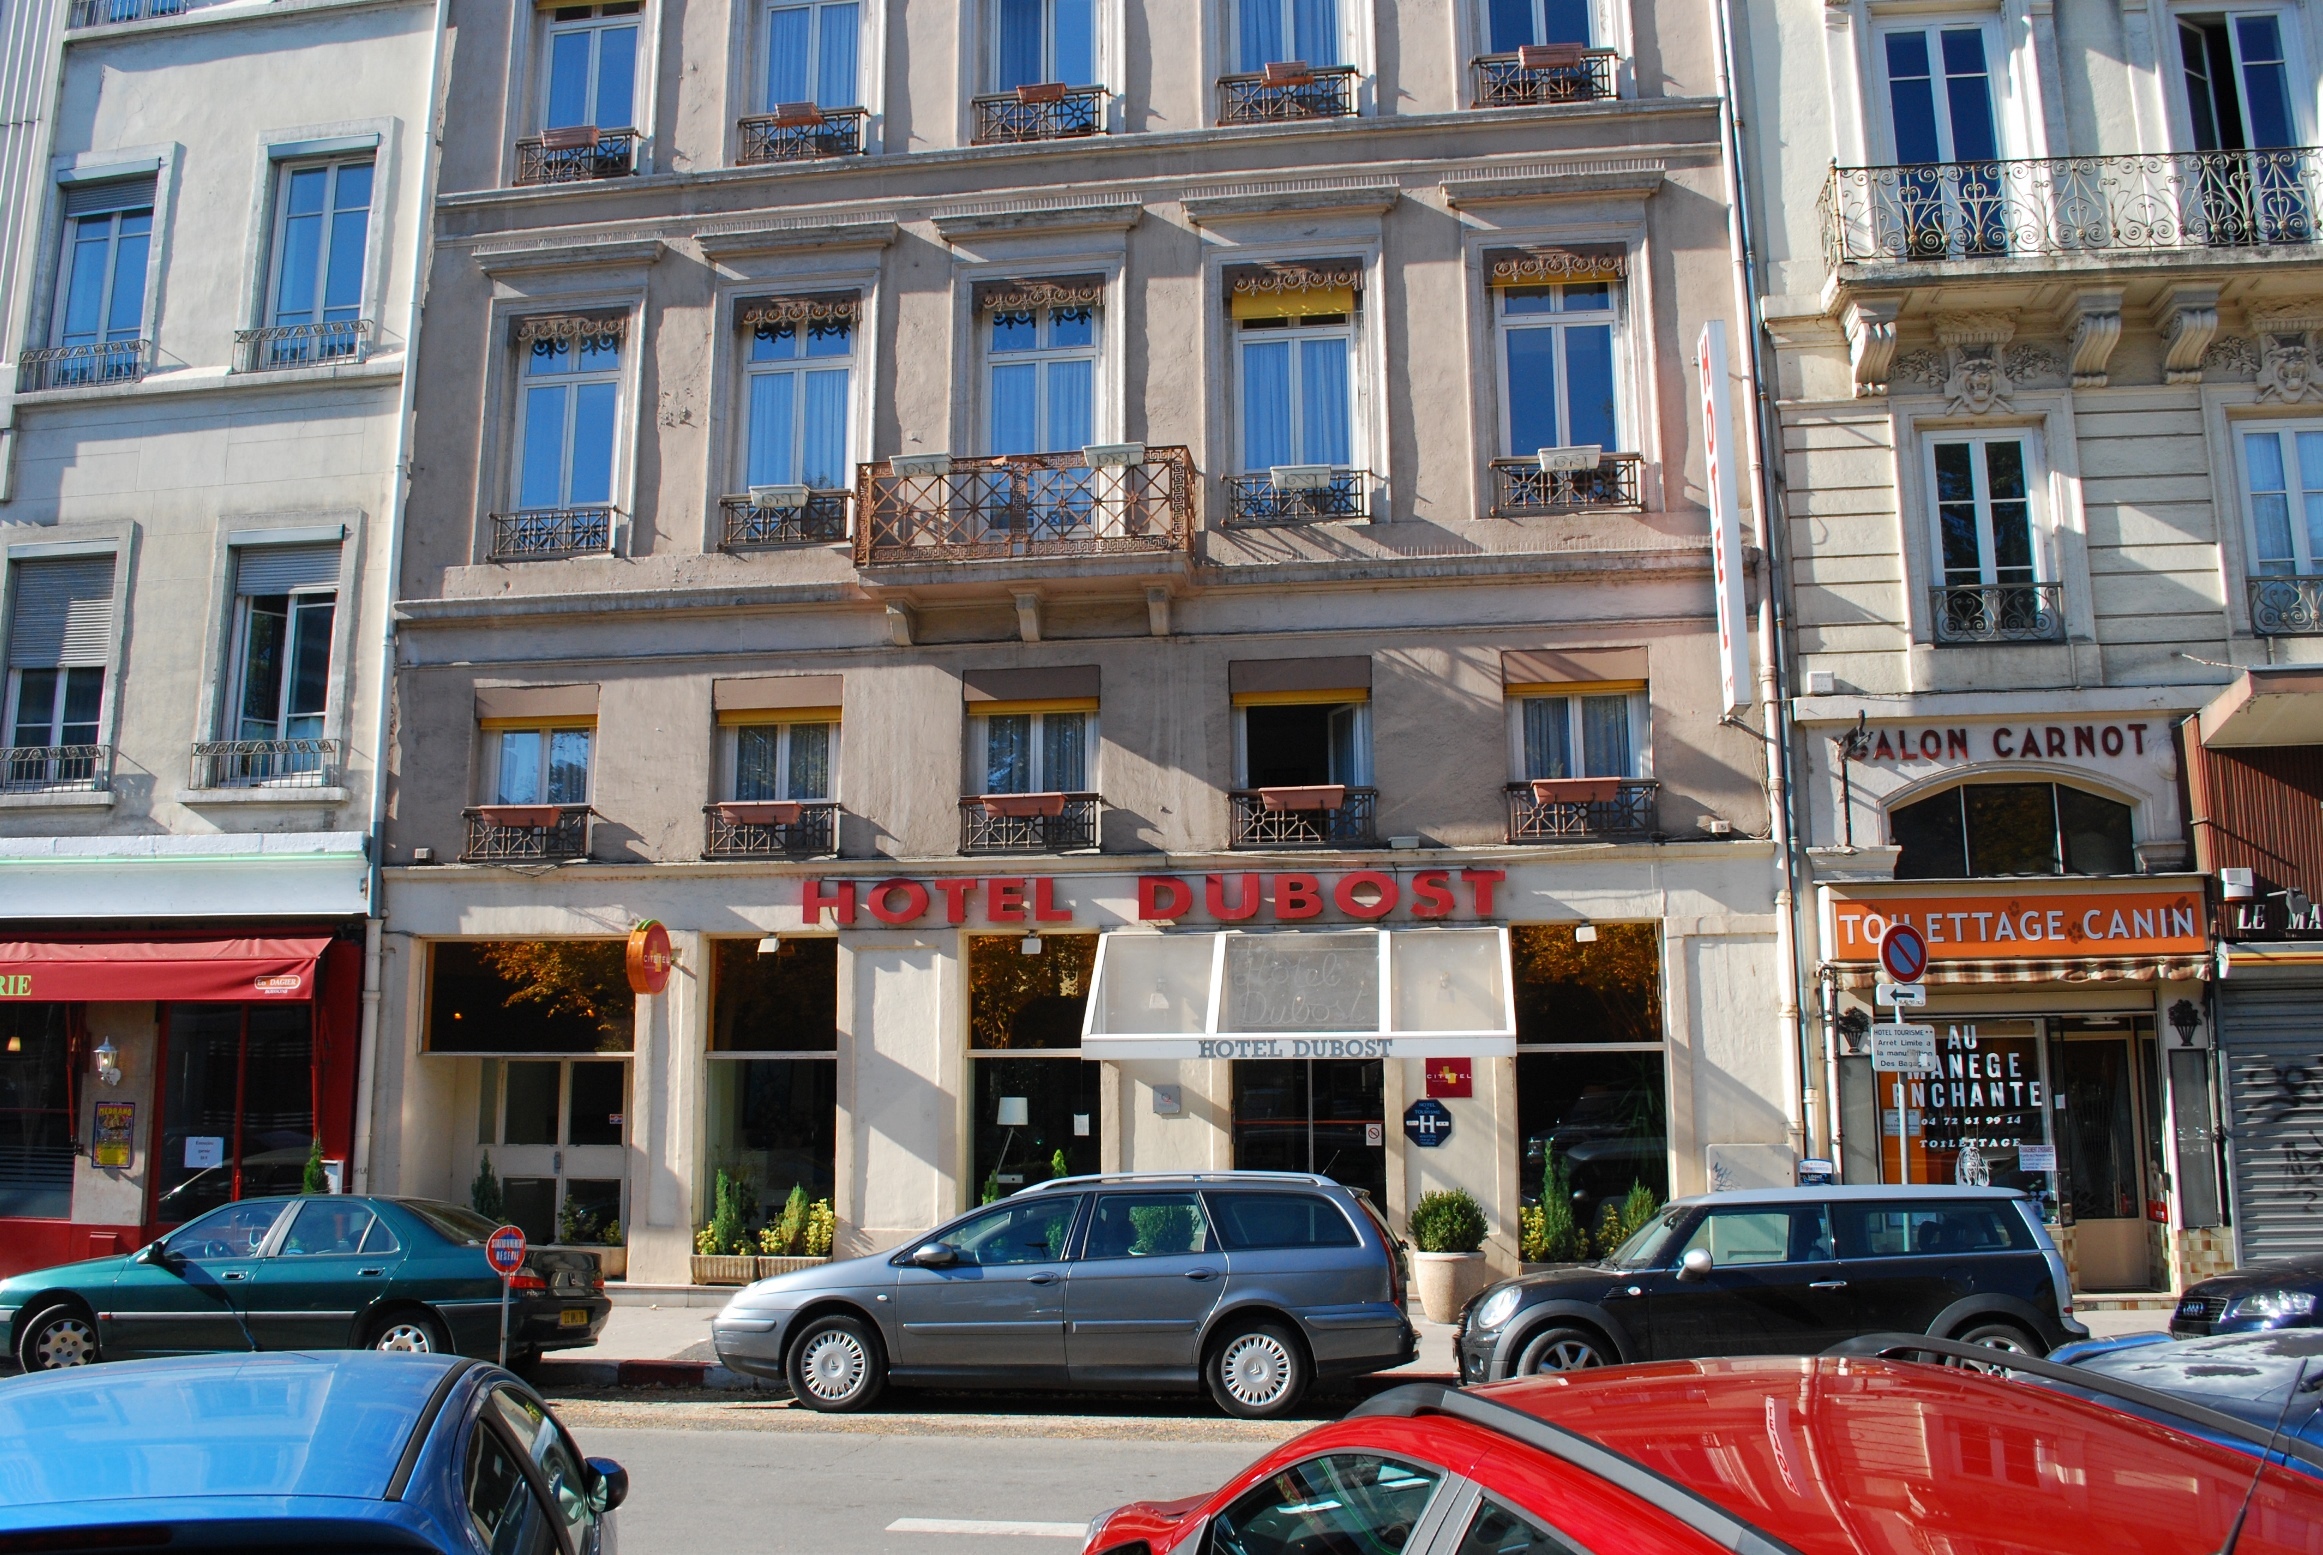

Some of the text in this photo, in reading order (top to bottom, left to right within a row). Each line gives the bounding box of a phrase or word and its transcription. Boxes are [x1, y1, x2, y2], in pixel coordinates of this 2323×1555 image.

[1701, 334, 1728, 650] HOTEL
[1993, 723, 2147, 758] CARNOT
[803, 870, 1505, 924] HOTEL DUBOST
[2083, 907, 2194, 939] CANIN
[2237, 904, 2265, 930] LE
[1198, 1038, 1393, 1058] HOTEL DUBOST
[1900, 1039, 1923, 1047] Limite
[1947, 1025, 1978, 1050] AU
[1898, 1060, 1930, 1068] Bagags
[1907, 1052, 2021, 1080] ANEGE
[1419, 1115, 1436, 1133] H
[1921, 1115, 2021, 1126] 04 72 61 99 14
